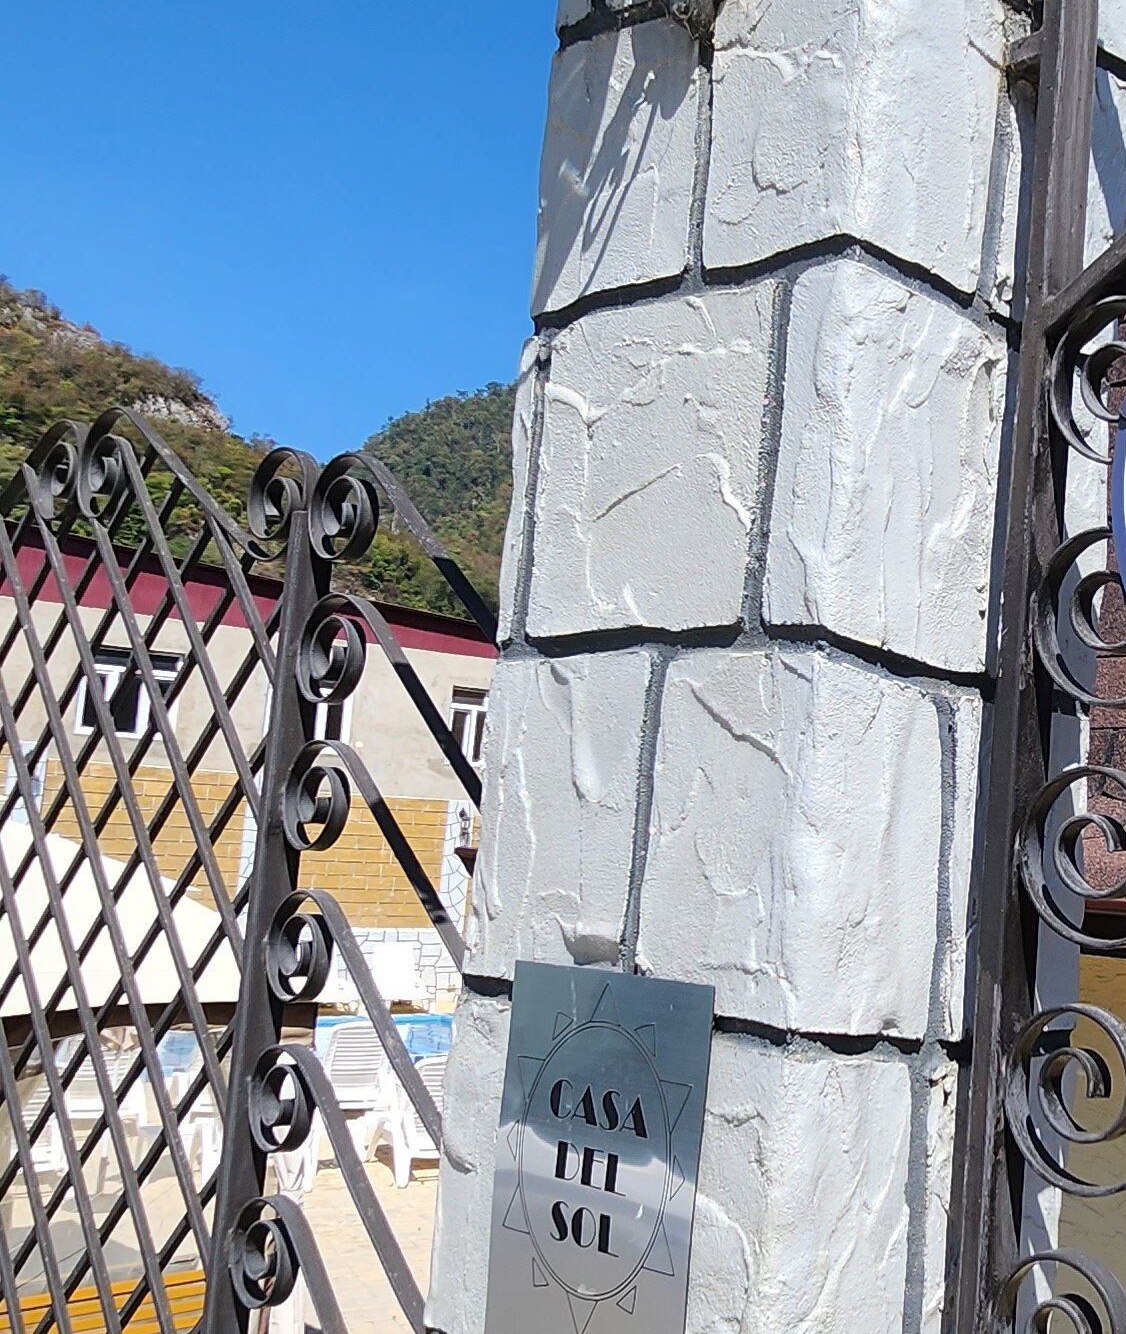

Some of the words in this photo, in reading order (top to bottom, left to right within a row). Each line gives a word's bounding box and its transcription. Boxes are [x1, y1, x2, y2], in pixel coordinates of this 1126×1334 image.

[549, 1078, 649, 1139] CASA
[554, 1140, 627, 1198] DEL
[549, 1200, 620, 1259] SOL
